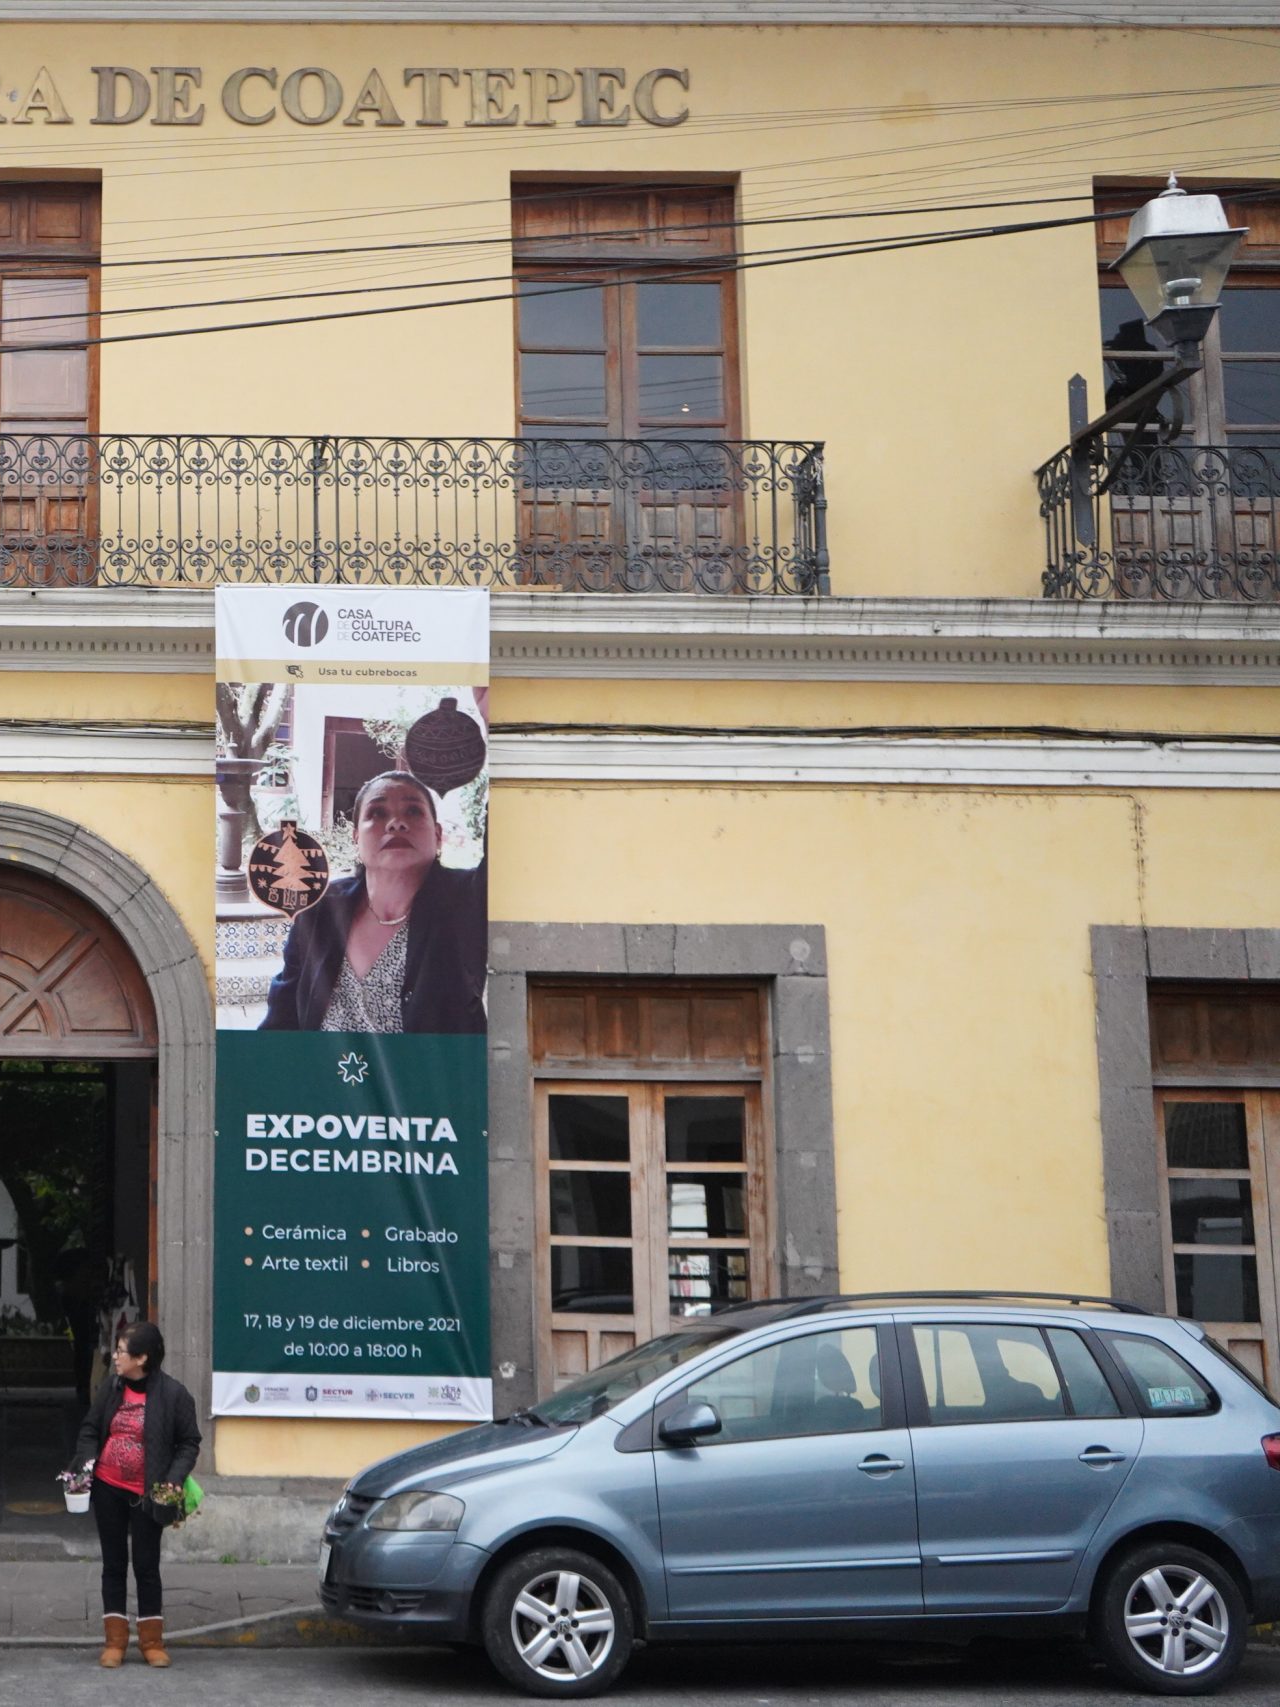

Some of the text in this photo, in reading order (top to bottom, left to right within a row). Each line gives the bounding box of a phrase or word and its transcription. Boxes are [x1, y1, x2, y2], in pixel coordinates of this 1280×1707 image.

[90, 65, 205, 127] DE
[221, 66, 690, 128] COATEPEC
[337, 608, 374, 620] CASA
[337, 619, 414, 632] DE CULTURA
[337, 631, 422, 643] DE COATEPEC
[318, 667, 418, 678] Usa tu cubrebocas
[246, 1113, 458, 1142] EXPOVENTA
[245, 1149, 460, 1176] DECEMBRINA
[261, 1224, 348, 1241] Cerámica
[385, 1226, 459, 1244] Grabado
[261, 1256, 349, 1272] Arte textil
[387, 1257, 440, 1274] Libros
[243, 1314, 461, 1332] 17, 18 y 19 de diciembre 2021
[284, 1342, 423, 1359] de 10:00 a 18:00 h
[322, 1388, 353, 1396] SECTUR
[382, 1392, 415, 1400] SECVER
